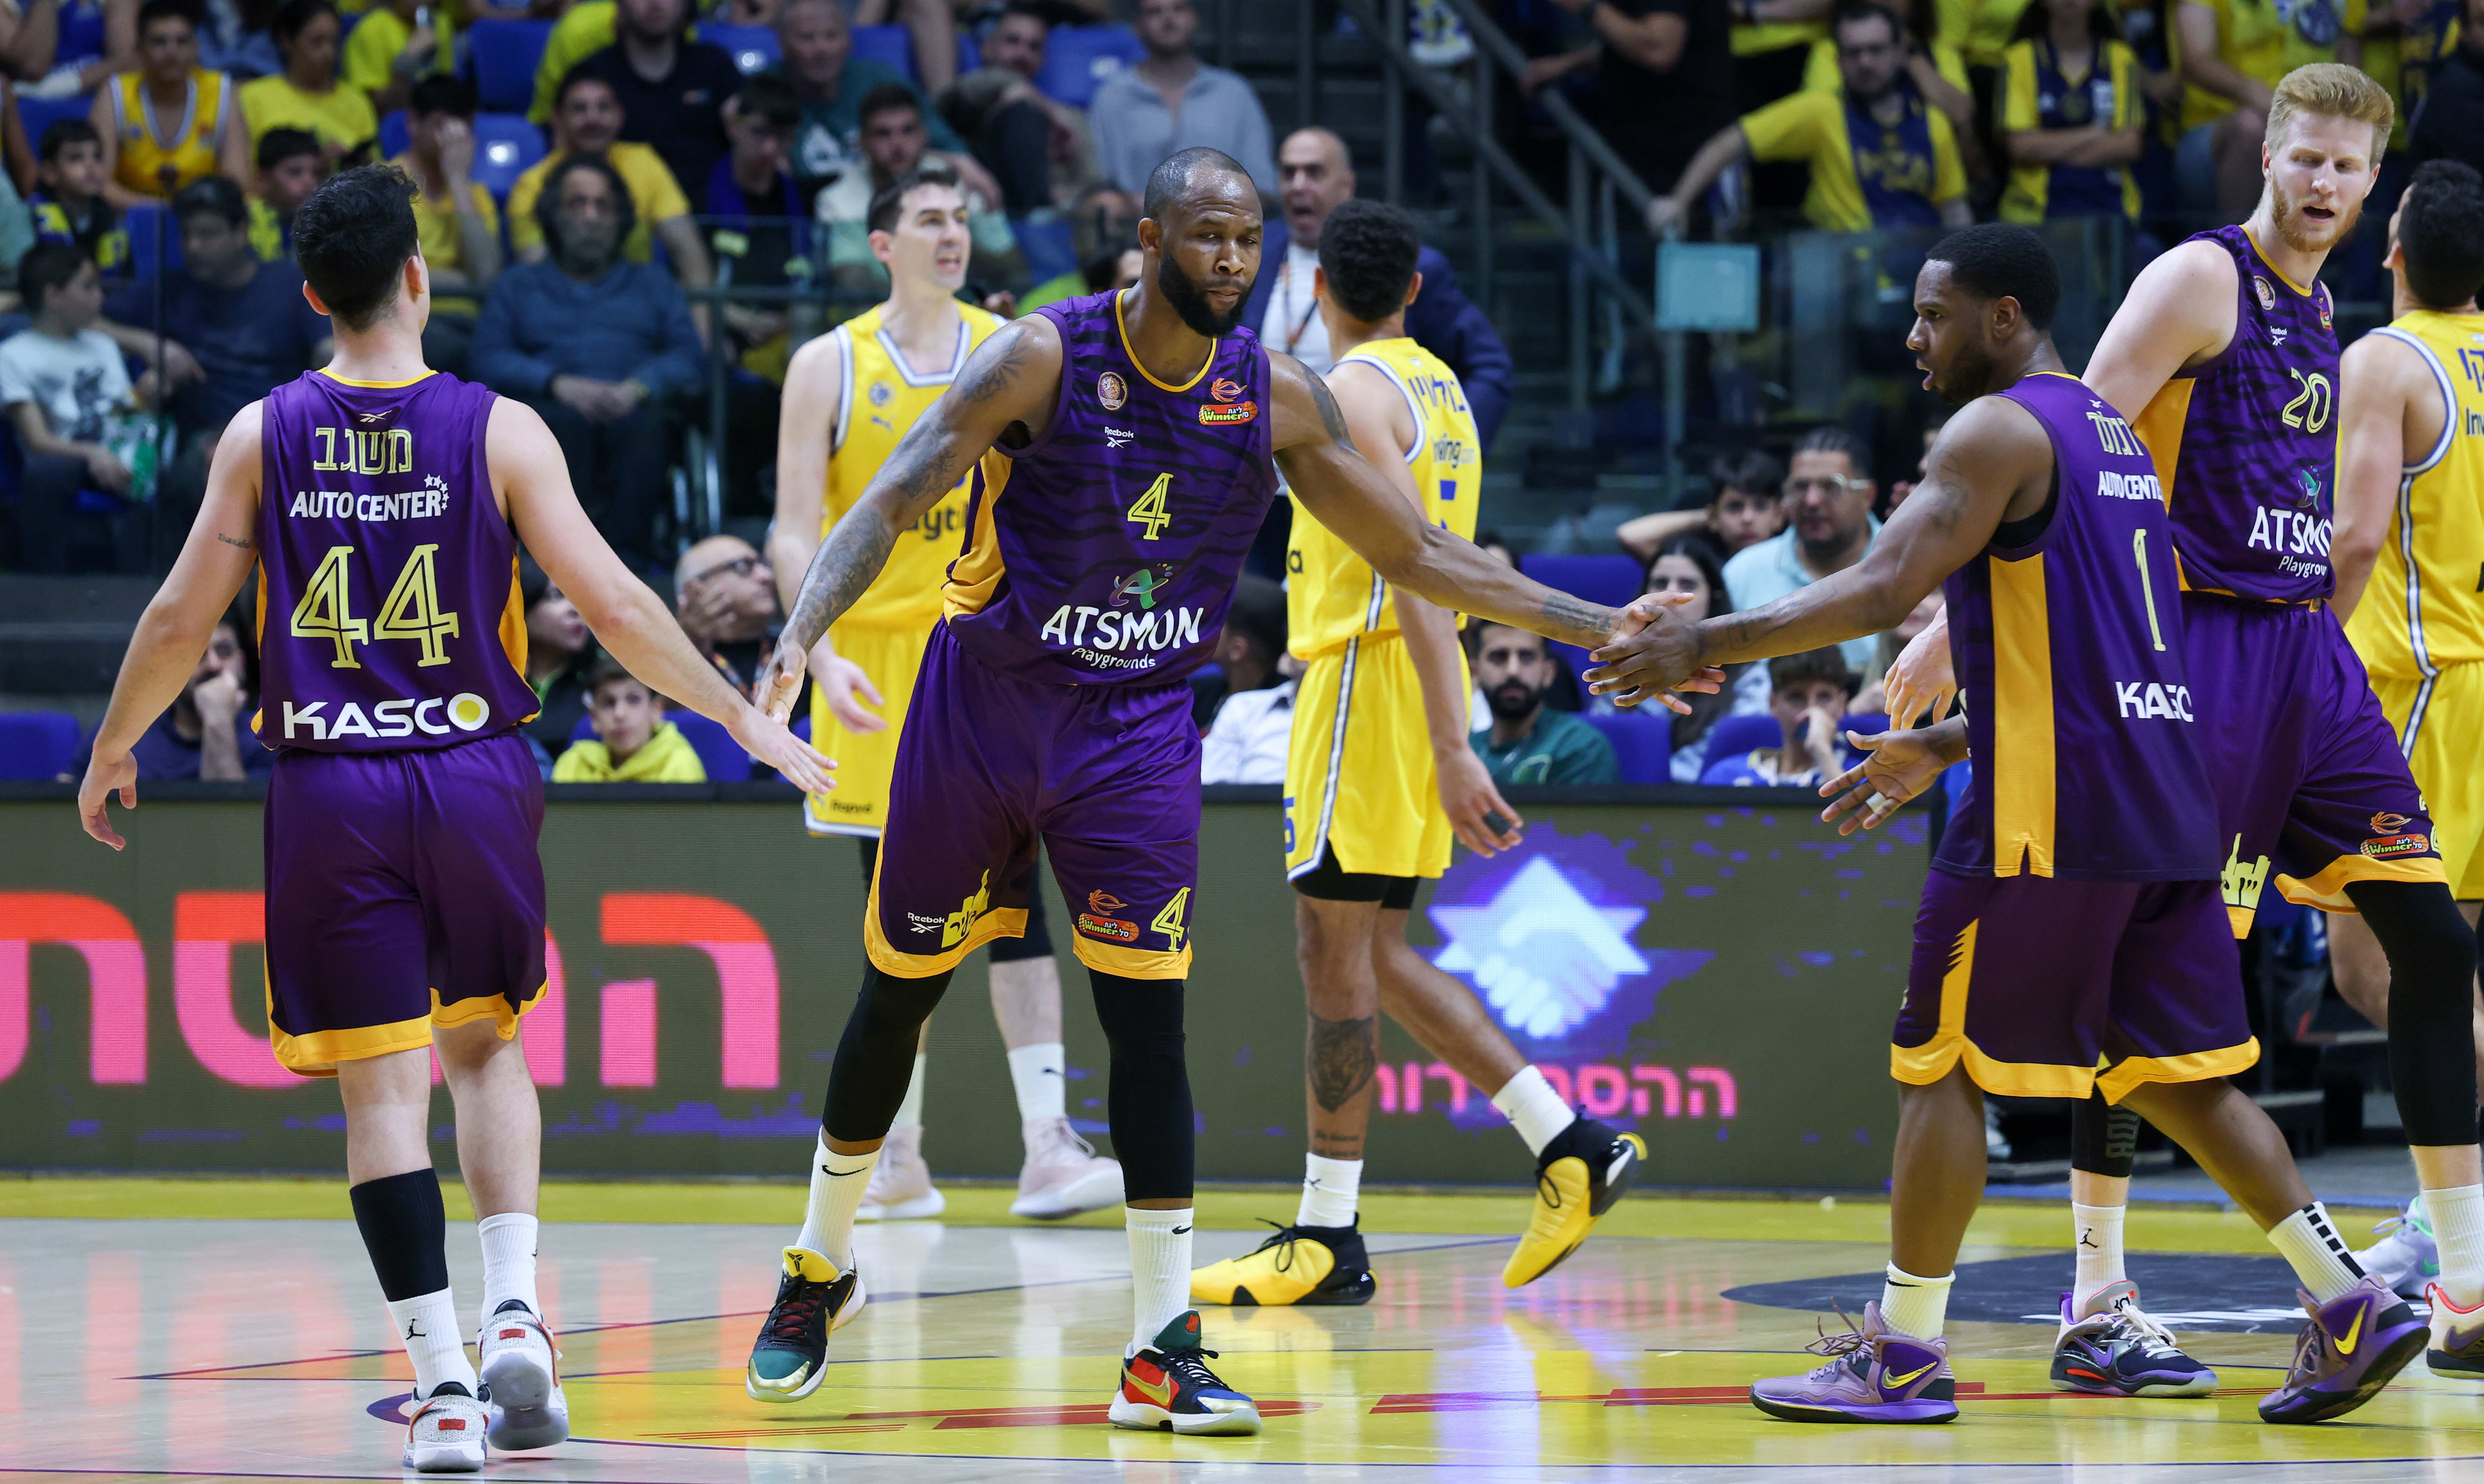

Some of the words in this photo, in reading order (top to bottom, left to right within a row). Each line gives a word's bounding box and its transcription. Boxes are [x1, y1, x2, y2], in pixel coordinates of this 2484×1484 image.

[1203, 410, 1243, 421] Winner
[2282, 366, 2331, 433] 20
[1104, 426, 1134, 438] Reebok
[313, 427, 412, 475] משגב
[2097, 471, 2124, 499] AUTO
[2124, 474, 2164, 502] CENTE
[289, 491, 354, 518] AUTO
[356, 489, 442, 522] CENTER
[1126, 472, 1174, 541] 4
[2247, 505, 2332, 558] ATSMO
[2278, 555, 2328, 579] Playgrou
[290, 543, 460, 669] 44
[2133, 528, 2167, 652] 1
[1041, 604, 1203, 651] ATSMON
[1071, 647, 1156, 669] Playgrounds
[282, 692, 490, 740] KASCO
[2368, 843, 2413, 854] Winner
[907, 912, 945, 923] Reebok
[1084, 918, 1118, 936] Winner
[1118, 928, 1129, 938] סל
[1150, 887, 1191, 951] 4
